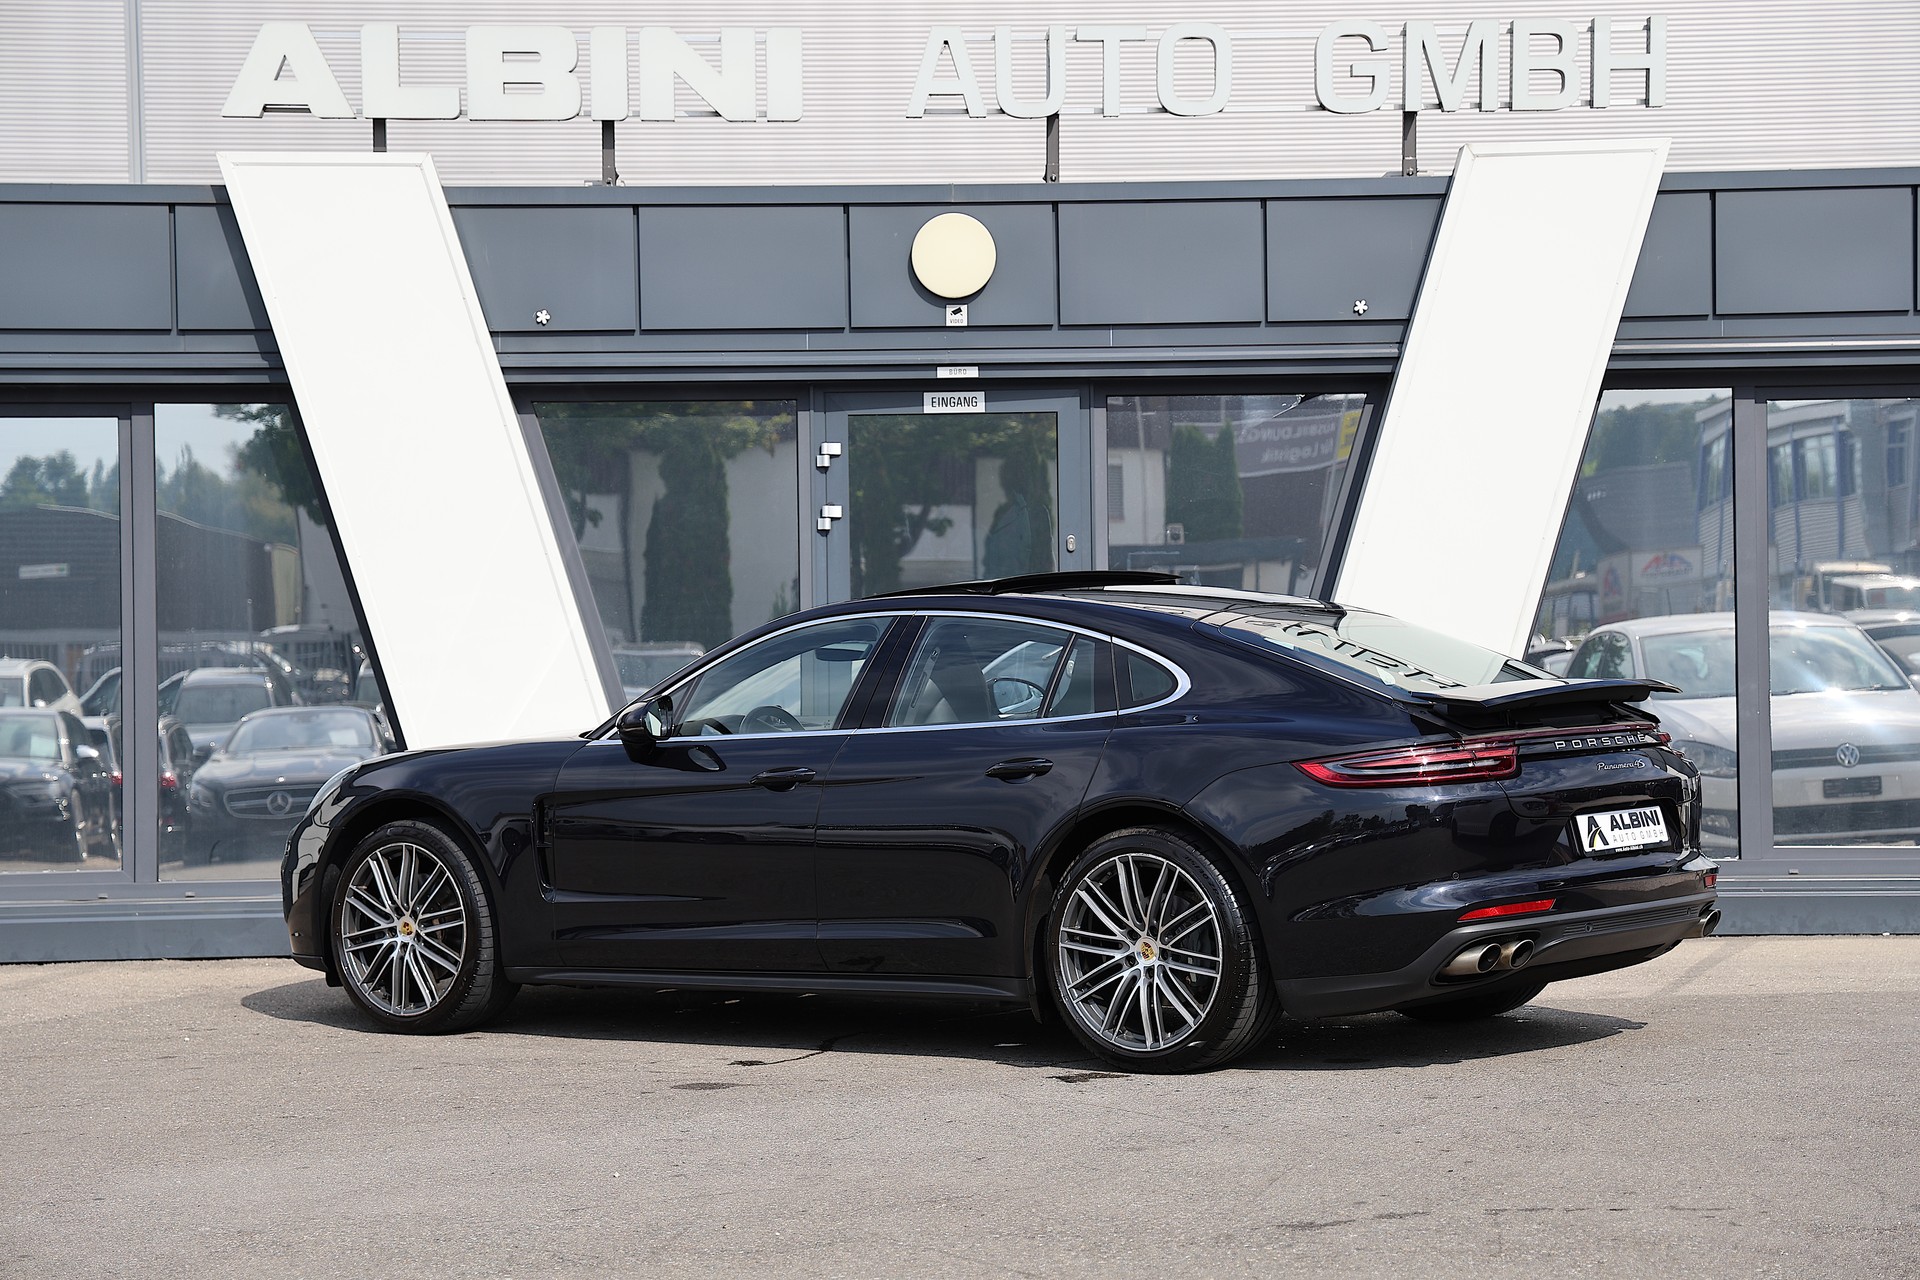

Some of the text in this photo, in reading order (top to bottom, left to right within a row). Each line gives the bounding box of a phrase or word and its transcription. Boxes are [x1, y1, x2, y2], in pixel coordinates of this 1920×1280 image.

[221, 16, 1668, 122] ALBINI AUTO GMBH
[948, 368, 967, 376] BÜRO
[931, 396, 978, 408] EINGANG
[1554, 733, 1646, 750] PORSCHE
[1596, 761, 1634, 771] Panamera
[1610, 809, 1661, 832] ALBINI
[1612, 829, 1665, 844] AUTO GMBH
